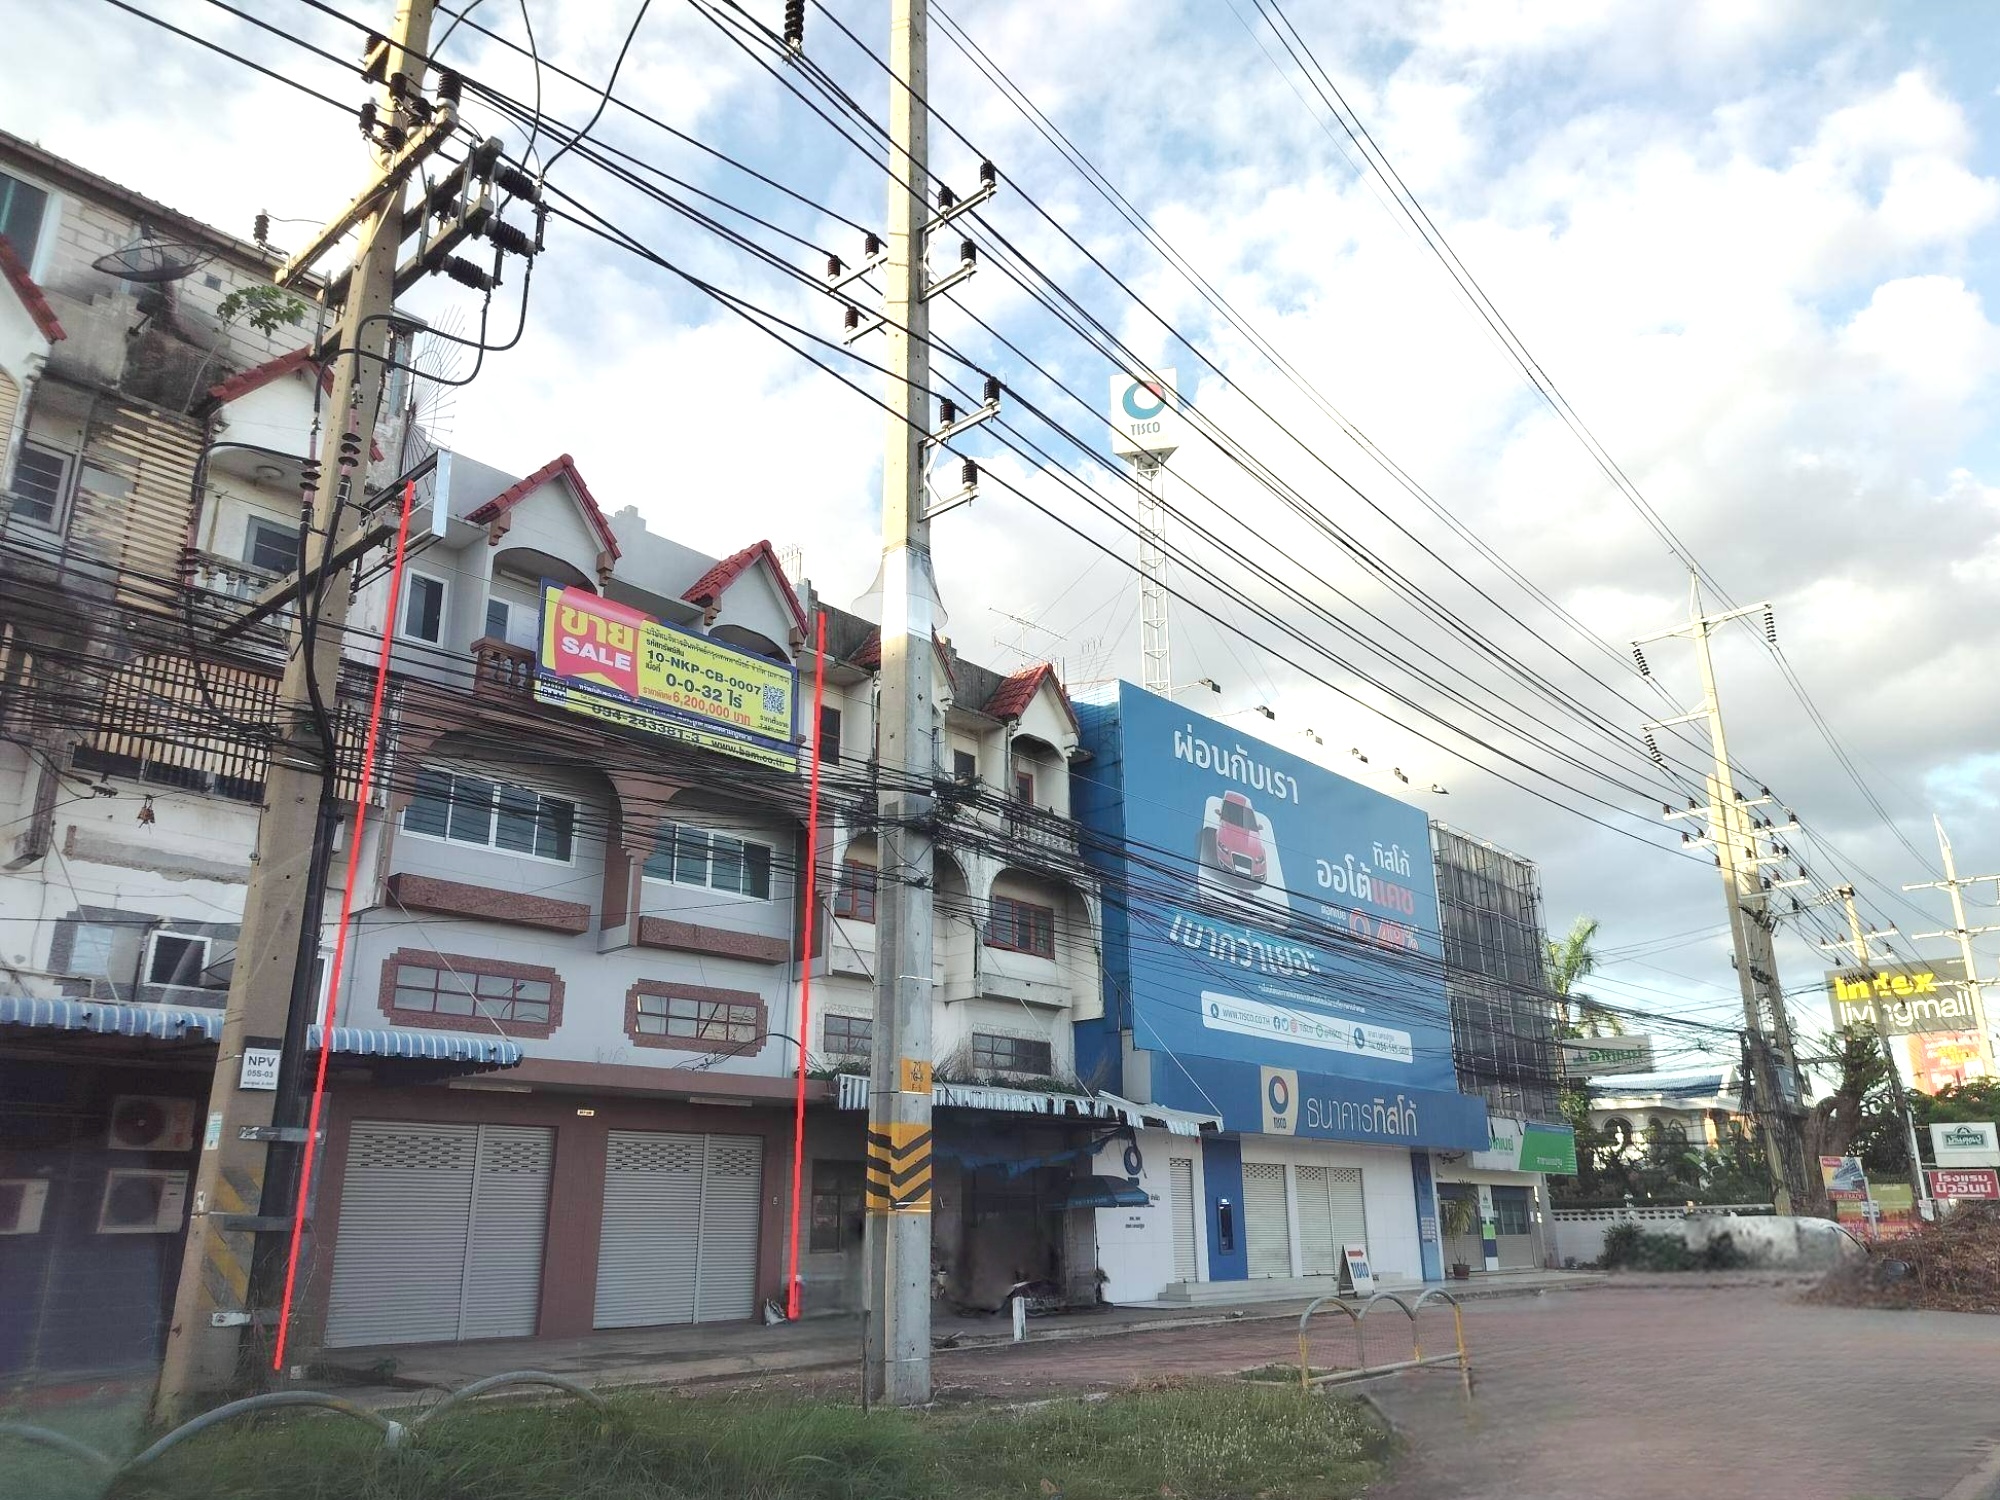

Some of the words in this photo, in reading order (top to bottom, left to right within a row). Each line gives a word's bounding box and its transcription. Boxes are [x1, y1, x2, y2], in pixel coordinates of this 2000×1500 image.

[1131, 421, 1161, 436] TISCO
[561, 605, 633, 653] ขาย
[561, 636, 632, 672] SALE
[647, 649, 762, 696] 10-NKP-CB-0007
[665, 673, 723, 703] 0-0-32
[726, 688, 742, 709] ไร่
[672, 691, 730, 719] 6,200,000
[733, 711, 751, 726] บาท
[1174, 723, 1299, 805] ผ่อนกับเรา
[1372, 840, 1411, 878] ทิสโก้
[247, 1069, 274, 1078] 05S-03
[248, 1055, 277, 1067] NPV
[1273, 1116, 1287, 1129] TISCO
[1306, 1094, 1418, 1137] ธนาคารทิสโก้
[1937, 1171, 1989, 1183] โรงแรม
